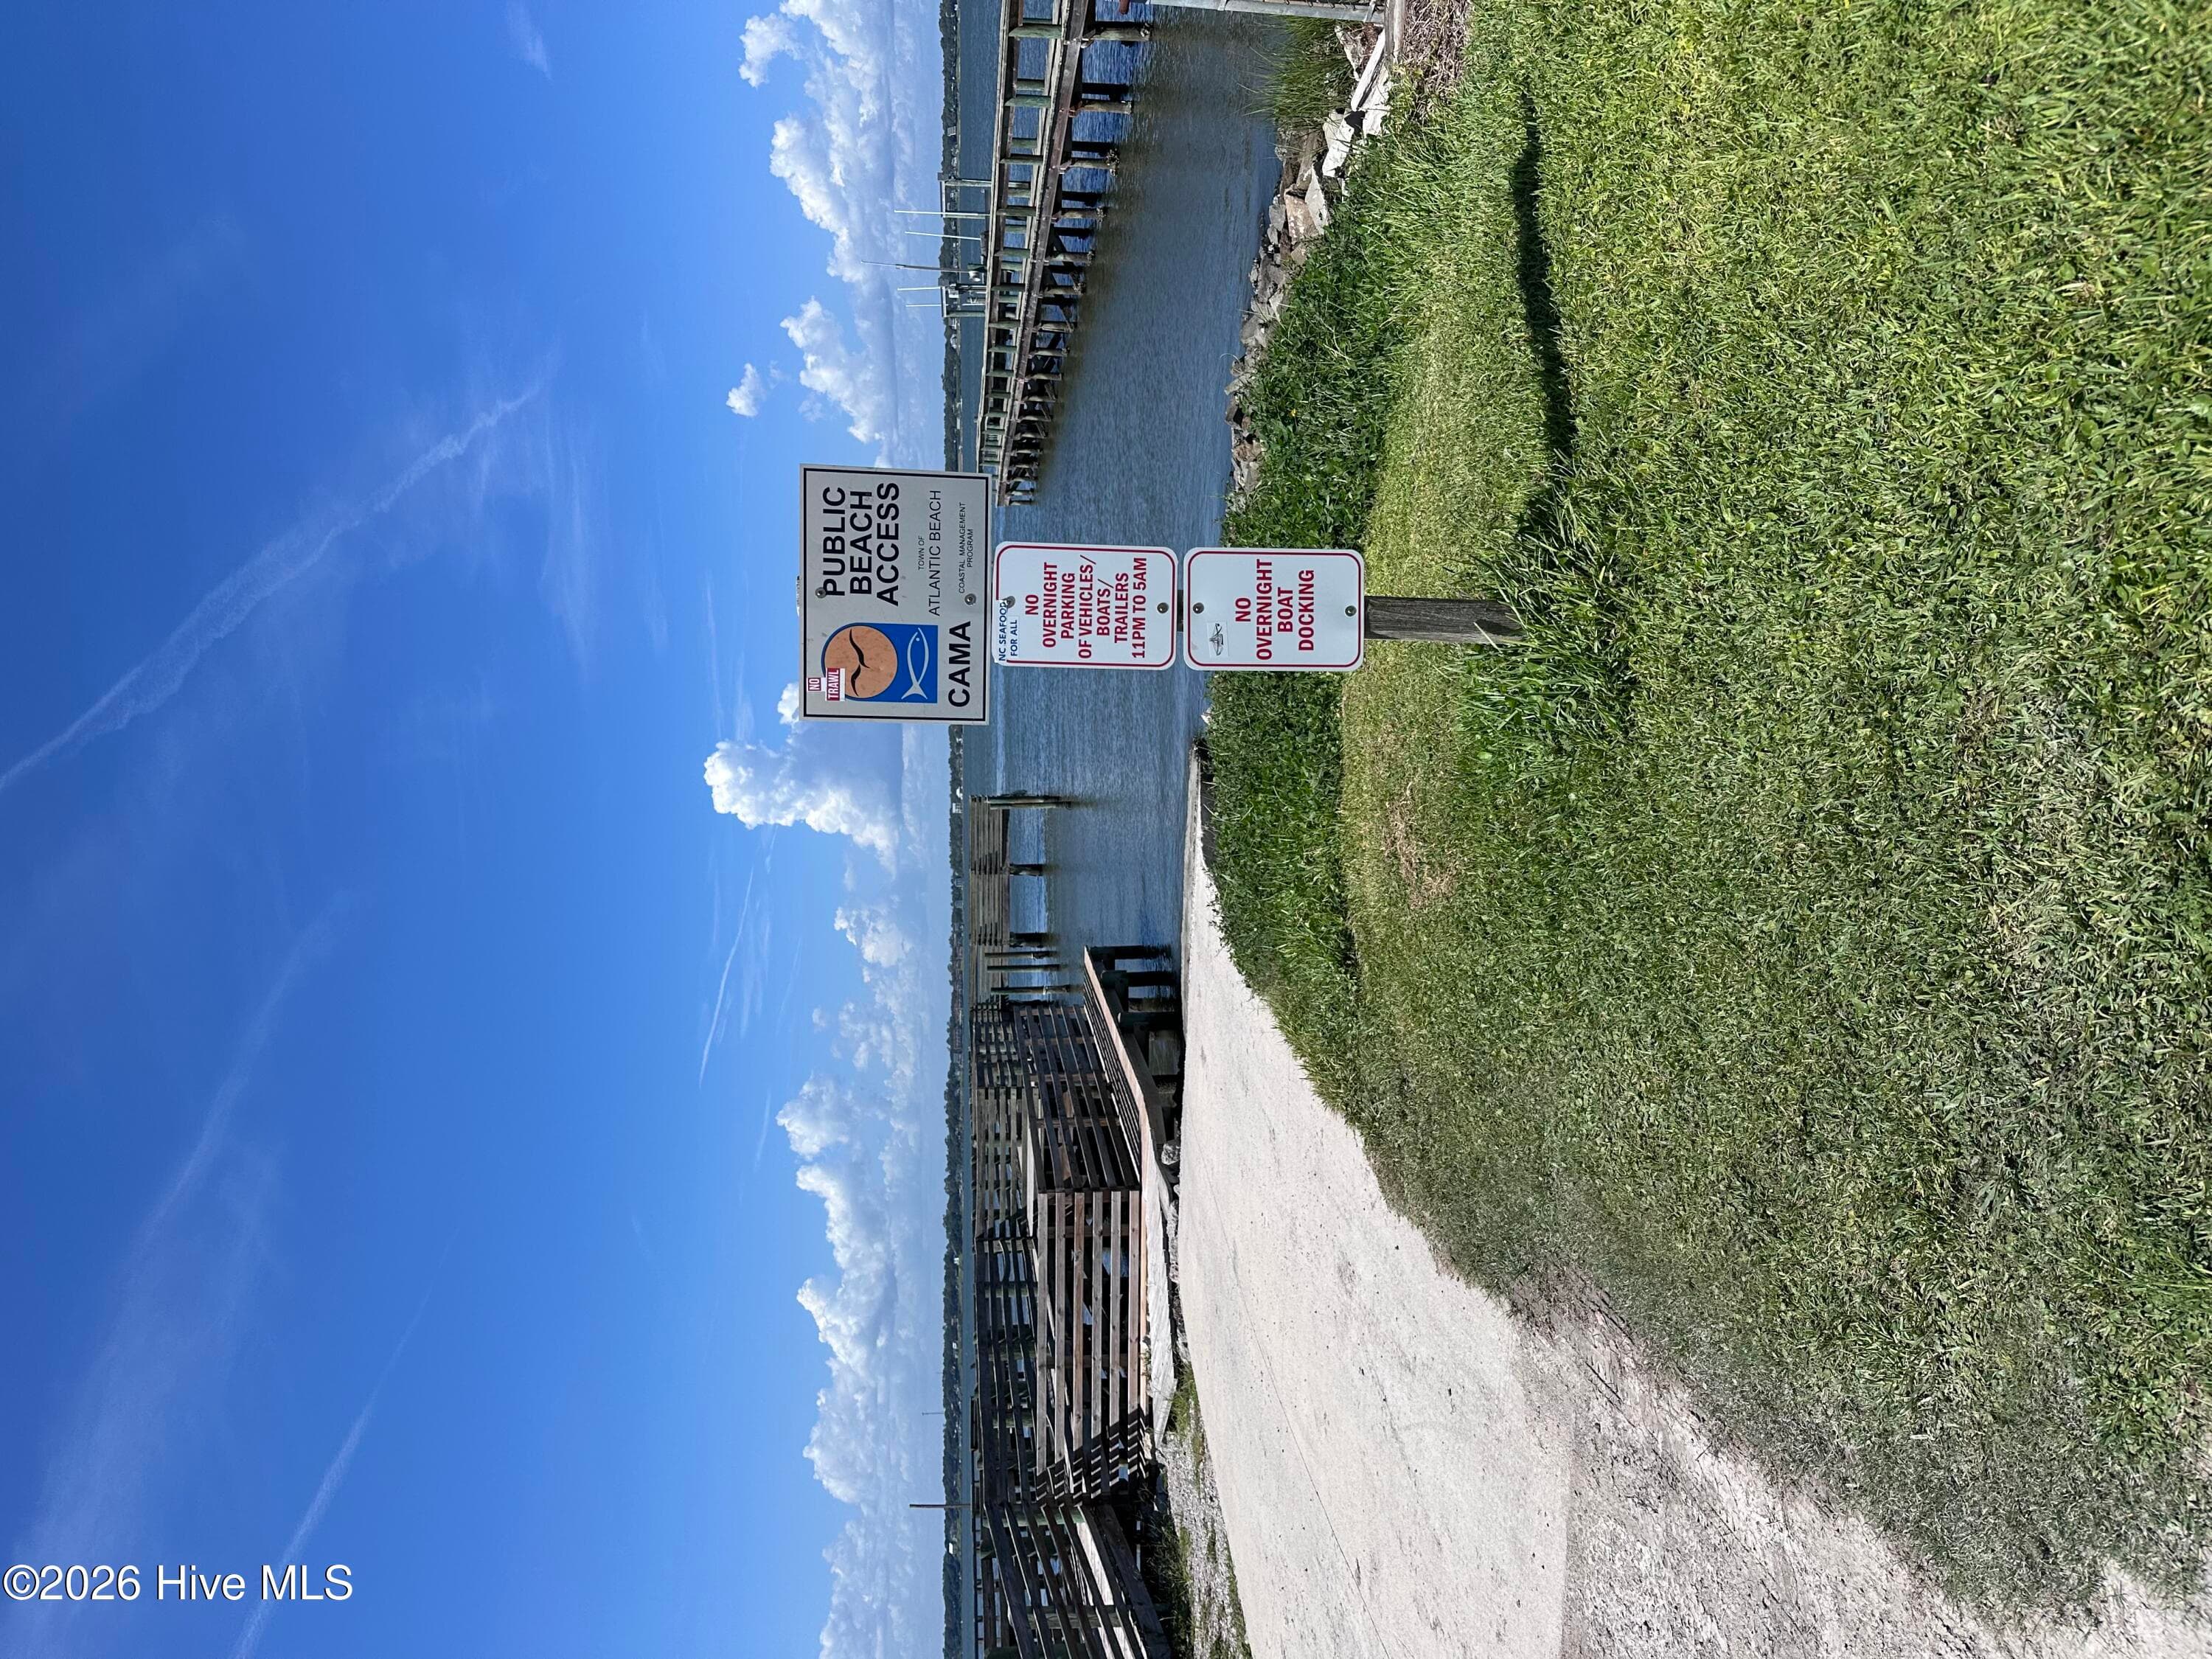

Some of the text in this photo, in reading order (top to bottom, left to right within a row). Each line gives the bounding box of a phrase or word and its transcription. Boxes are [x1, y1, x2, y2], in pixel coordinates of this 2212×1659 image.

[823, 487, 845, 597] PUBLIC
[849, 491, 872, 594] BEACH
[877, 482, 900, 606] ACCESS
[918, 535, 925, 546] OF
[928, 490, 942, 616] ATLANTIC BEACH
[1025, 594, 1039, 615] NO
[1043, 562, 1057, 647] OVERNIGHT
[1061, 573, 1075, 639] PARKING
[1079, 554, 1096, 658] OF VEHICLES/
[1097, 579, 1113, 636] BOATS/
[1115, 573, 1128, 643] TRAILERS
[1133, 557, 1147, 658] 11PM TO 5AM
[1236, 598, 1251, 622] NO
[1256, 559, 1272, 660] OVERNIGHT
[1278, 587, 1293, 632] BOAT
[1298, 570, 1314, 651] DOCKING
[809, 678, 820, 690] NO
[828, 669, 839, 699] TRAWL
[948, 621, 971, 707] CAMA
[999, 648, 1006, 661] NC
